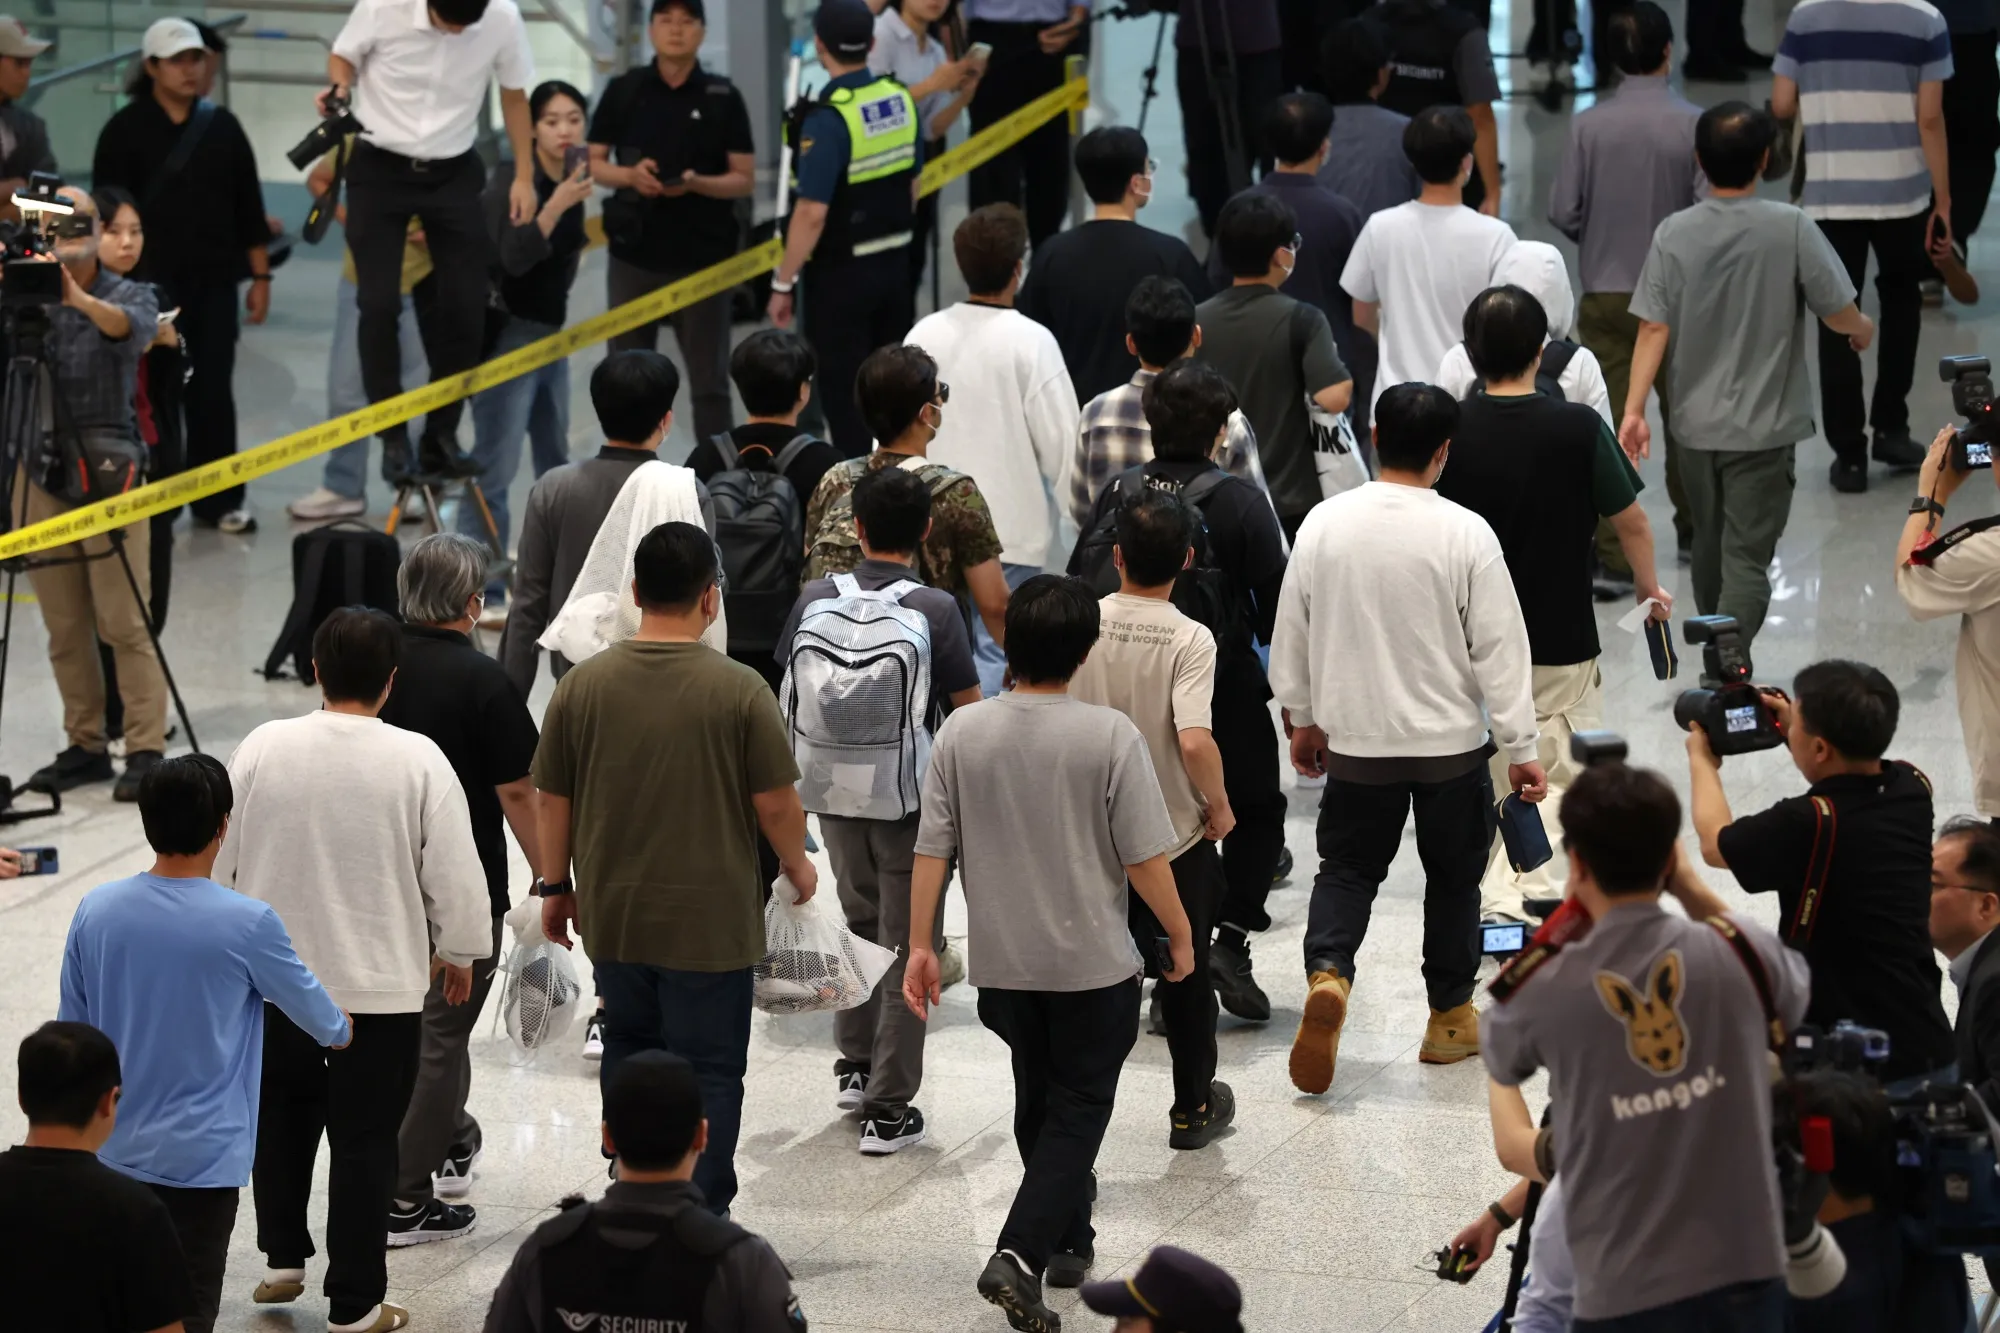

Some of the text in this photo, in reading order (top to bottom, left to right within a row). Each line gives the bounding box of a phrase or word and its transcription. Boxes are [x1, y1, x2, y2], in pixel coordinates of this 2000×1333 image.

[1944, 527, 1971, 544] Canon
[1111, 621, 1133, 631] THE
[1136, 624, 1176, 635] OCEAN
[1108, 631, 1129, 642] THE
[1132, 634, 1172, 645] WORLD
[599, 1314, 688, 1333] SECURITY
